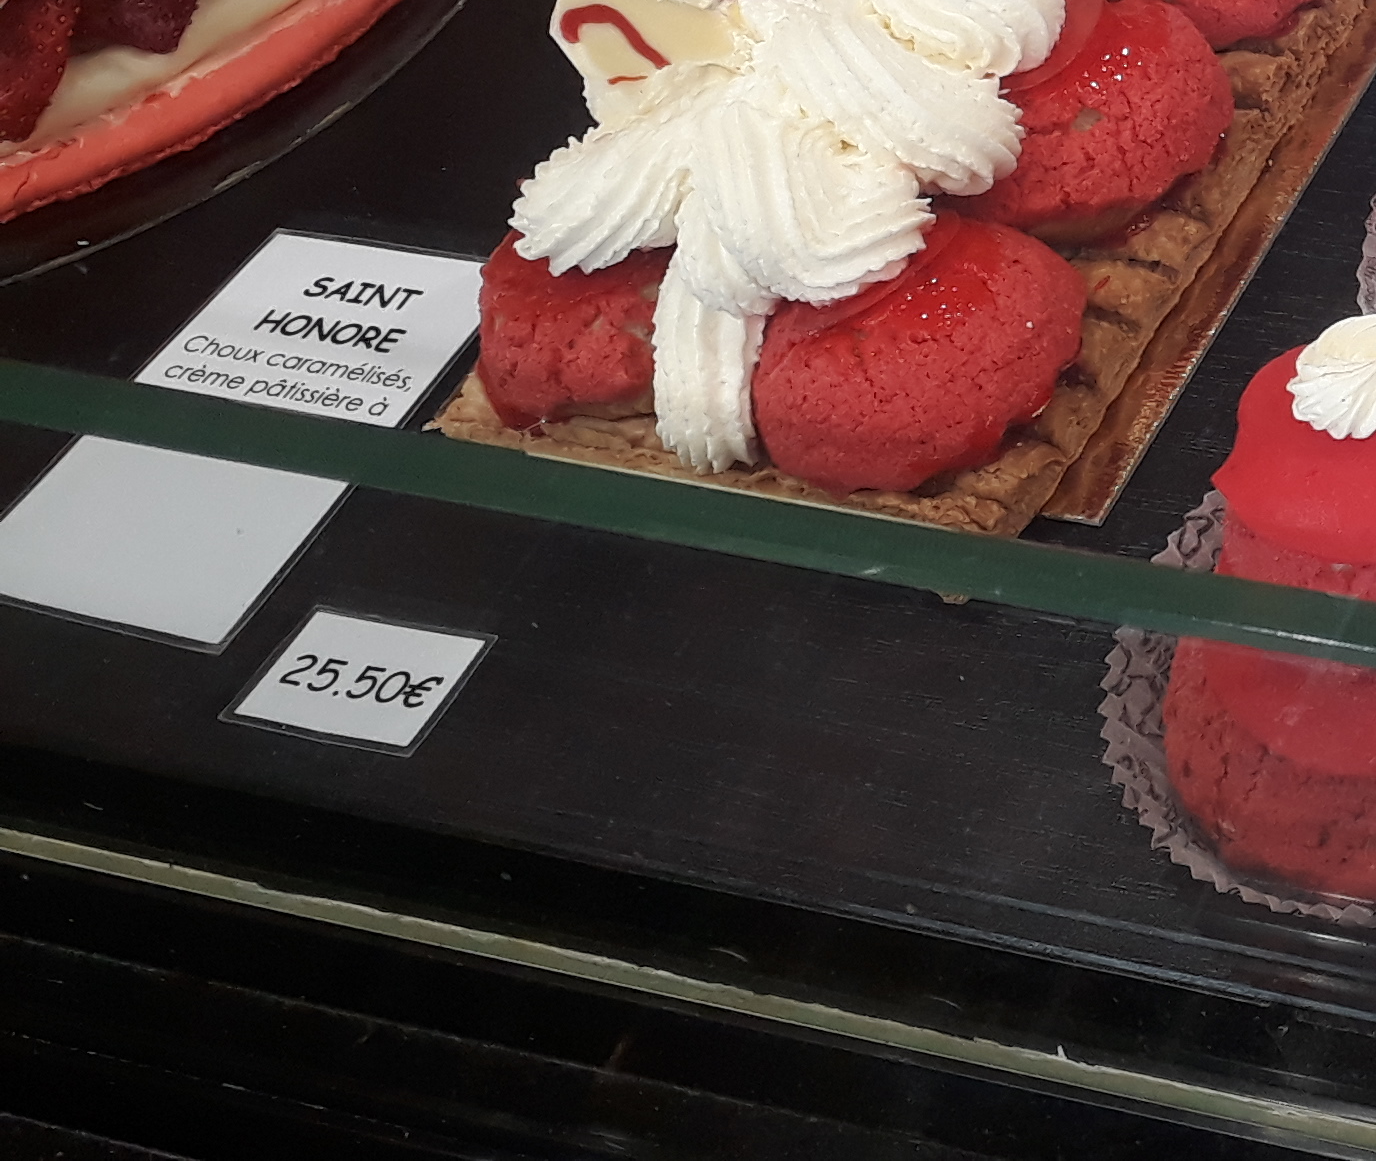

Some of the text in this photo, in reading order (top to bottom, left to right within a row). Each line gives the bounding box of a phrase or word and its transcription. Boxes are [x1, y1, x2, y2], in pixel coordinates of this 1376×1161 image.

[302, 275, 425, 312] SAINT
[252, 308, 408, 354] HONORE
[182, 334, 413, 393] Choux caramélisés,
[164, 364, 390, 417] crème pâtissière à
[278, 653, 445, 711] 25.50€
